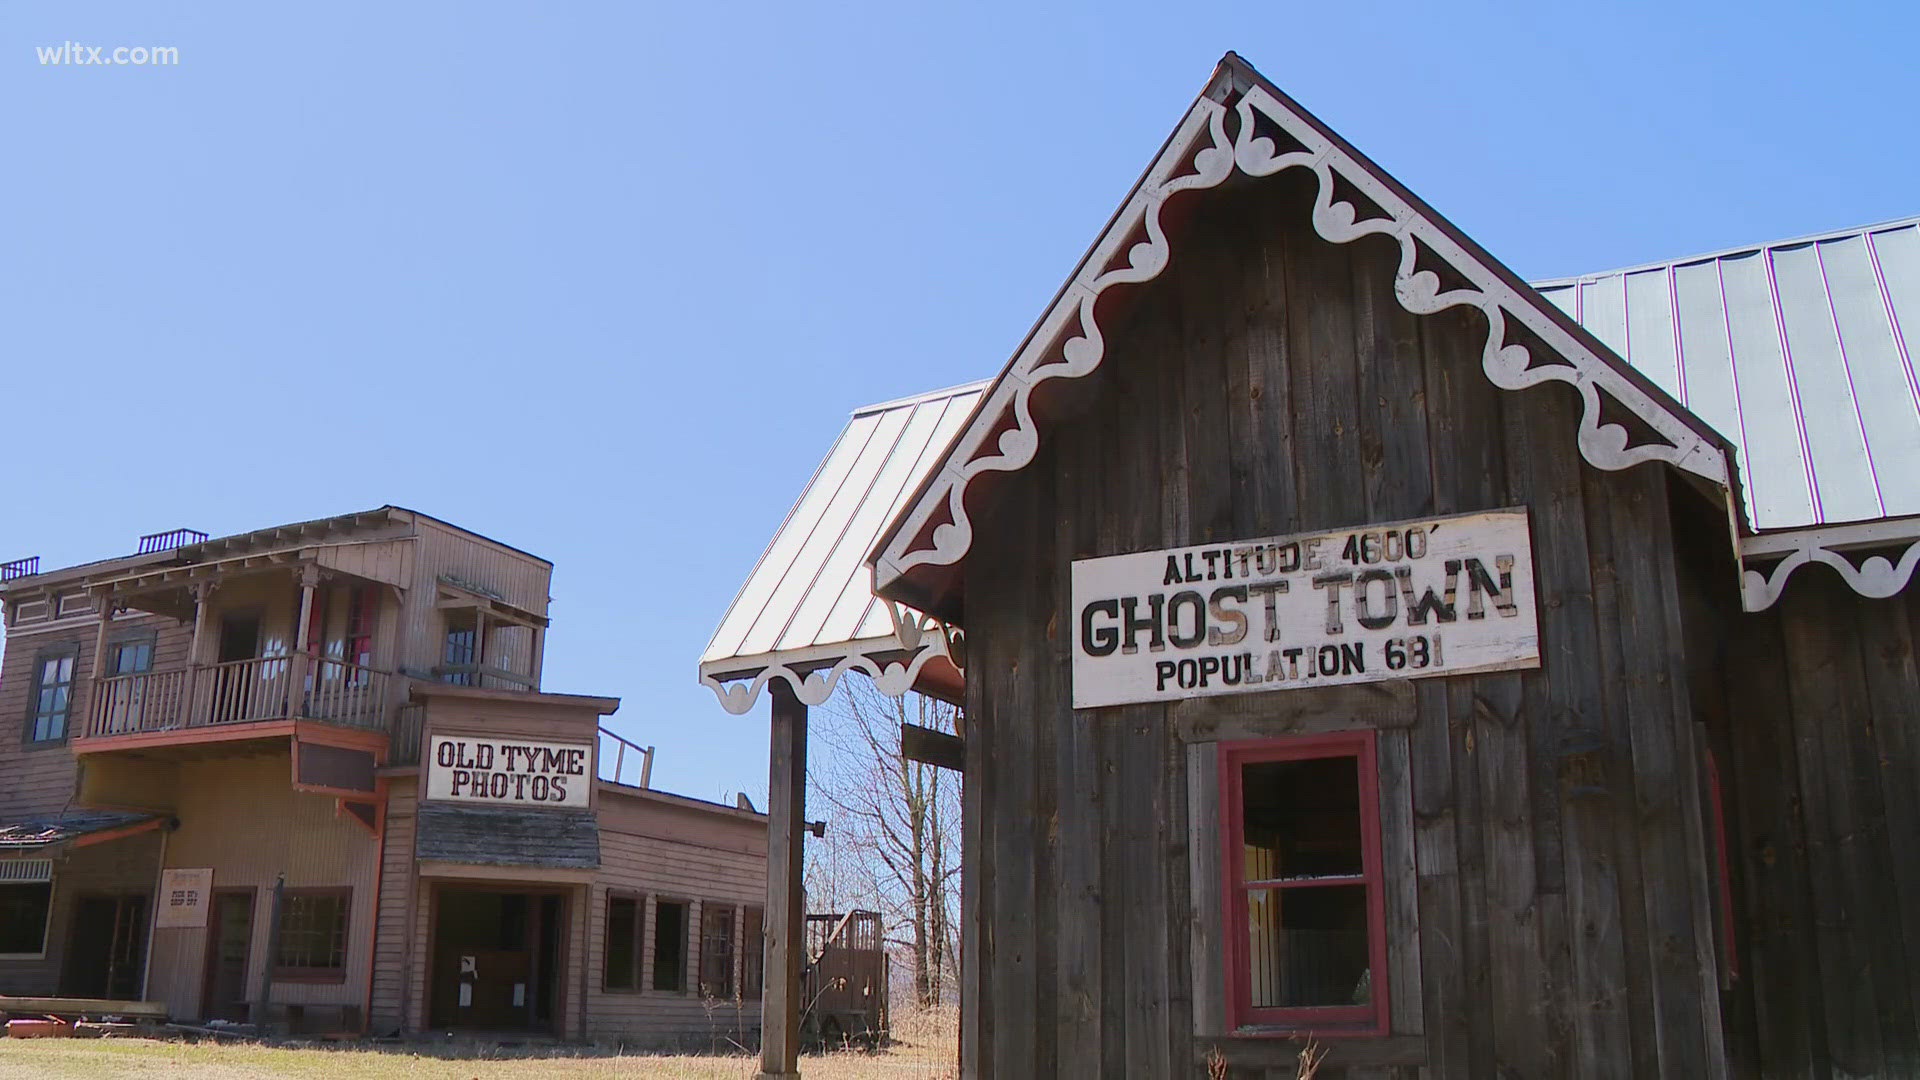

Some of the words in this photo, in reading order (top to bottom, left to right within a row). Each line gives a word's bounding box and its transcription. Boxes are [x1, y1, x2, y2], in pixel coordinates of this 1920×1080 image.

[1163, 538, 1323, 586] ALTITUDE
[1081, 580, 1289, 657] GHOST
[1313, 554, 1518, 635] TOWN
[1156, 643, 1365, 691] POPULATION
[1385, 633, 1444, 670] 681
[437, 741, 494, 769] OLD
[501, 745, 585, 775] TYME
[451, 770, 567, 802] PHOTOS
